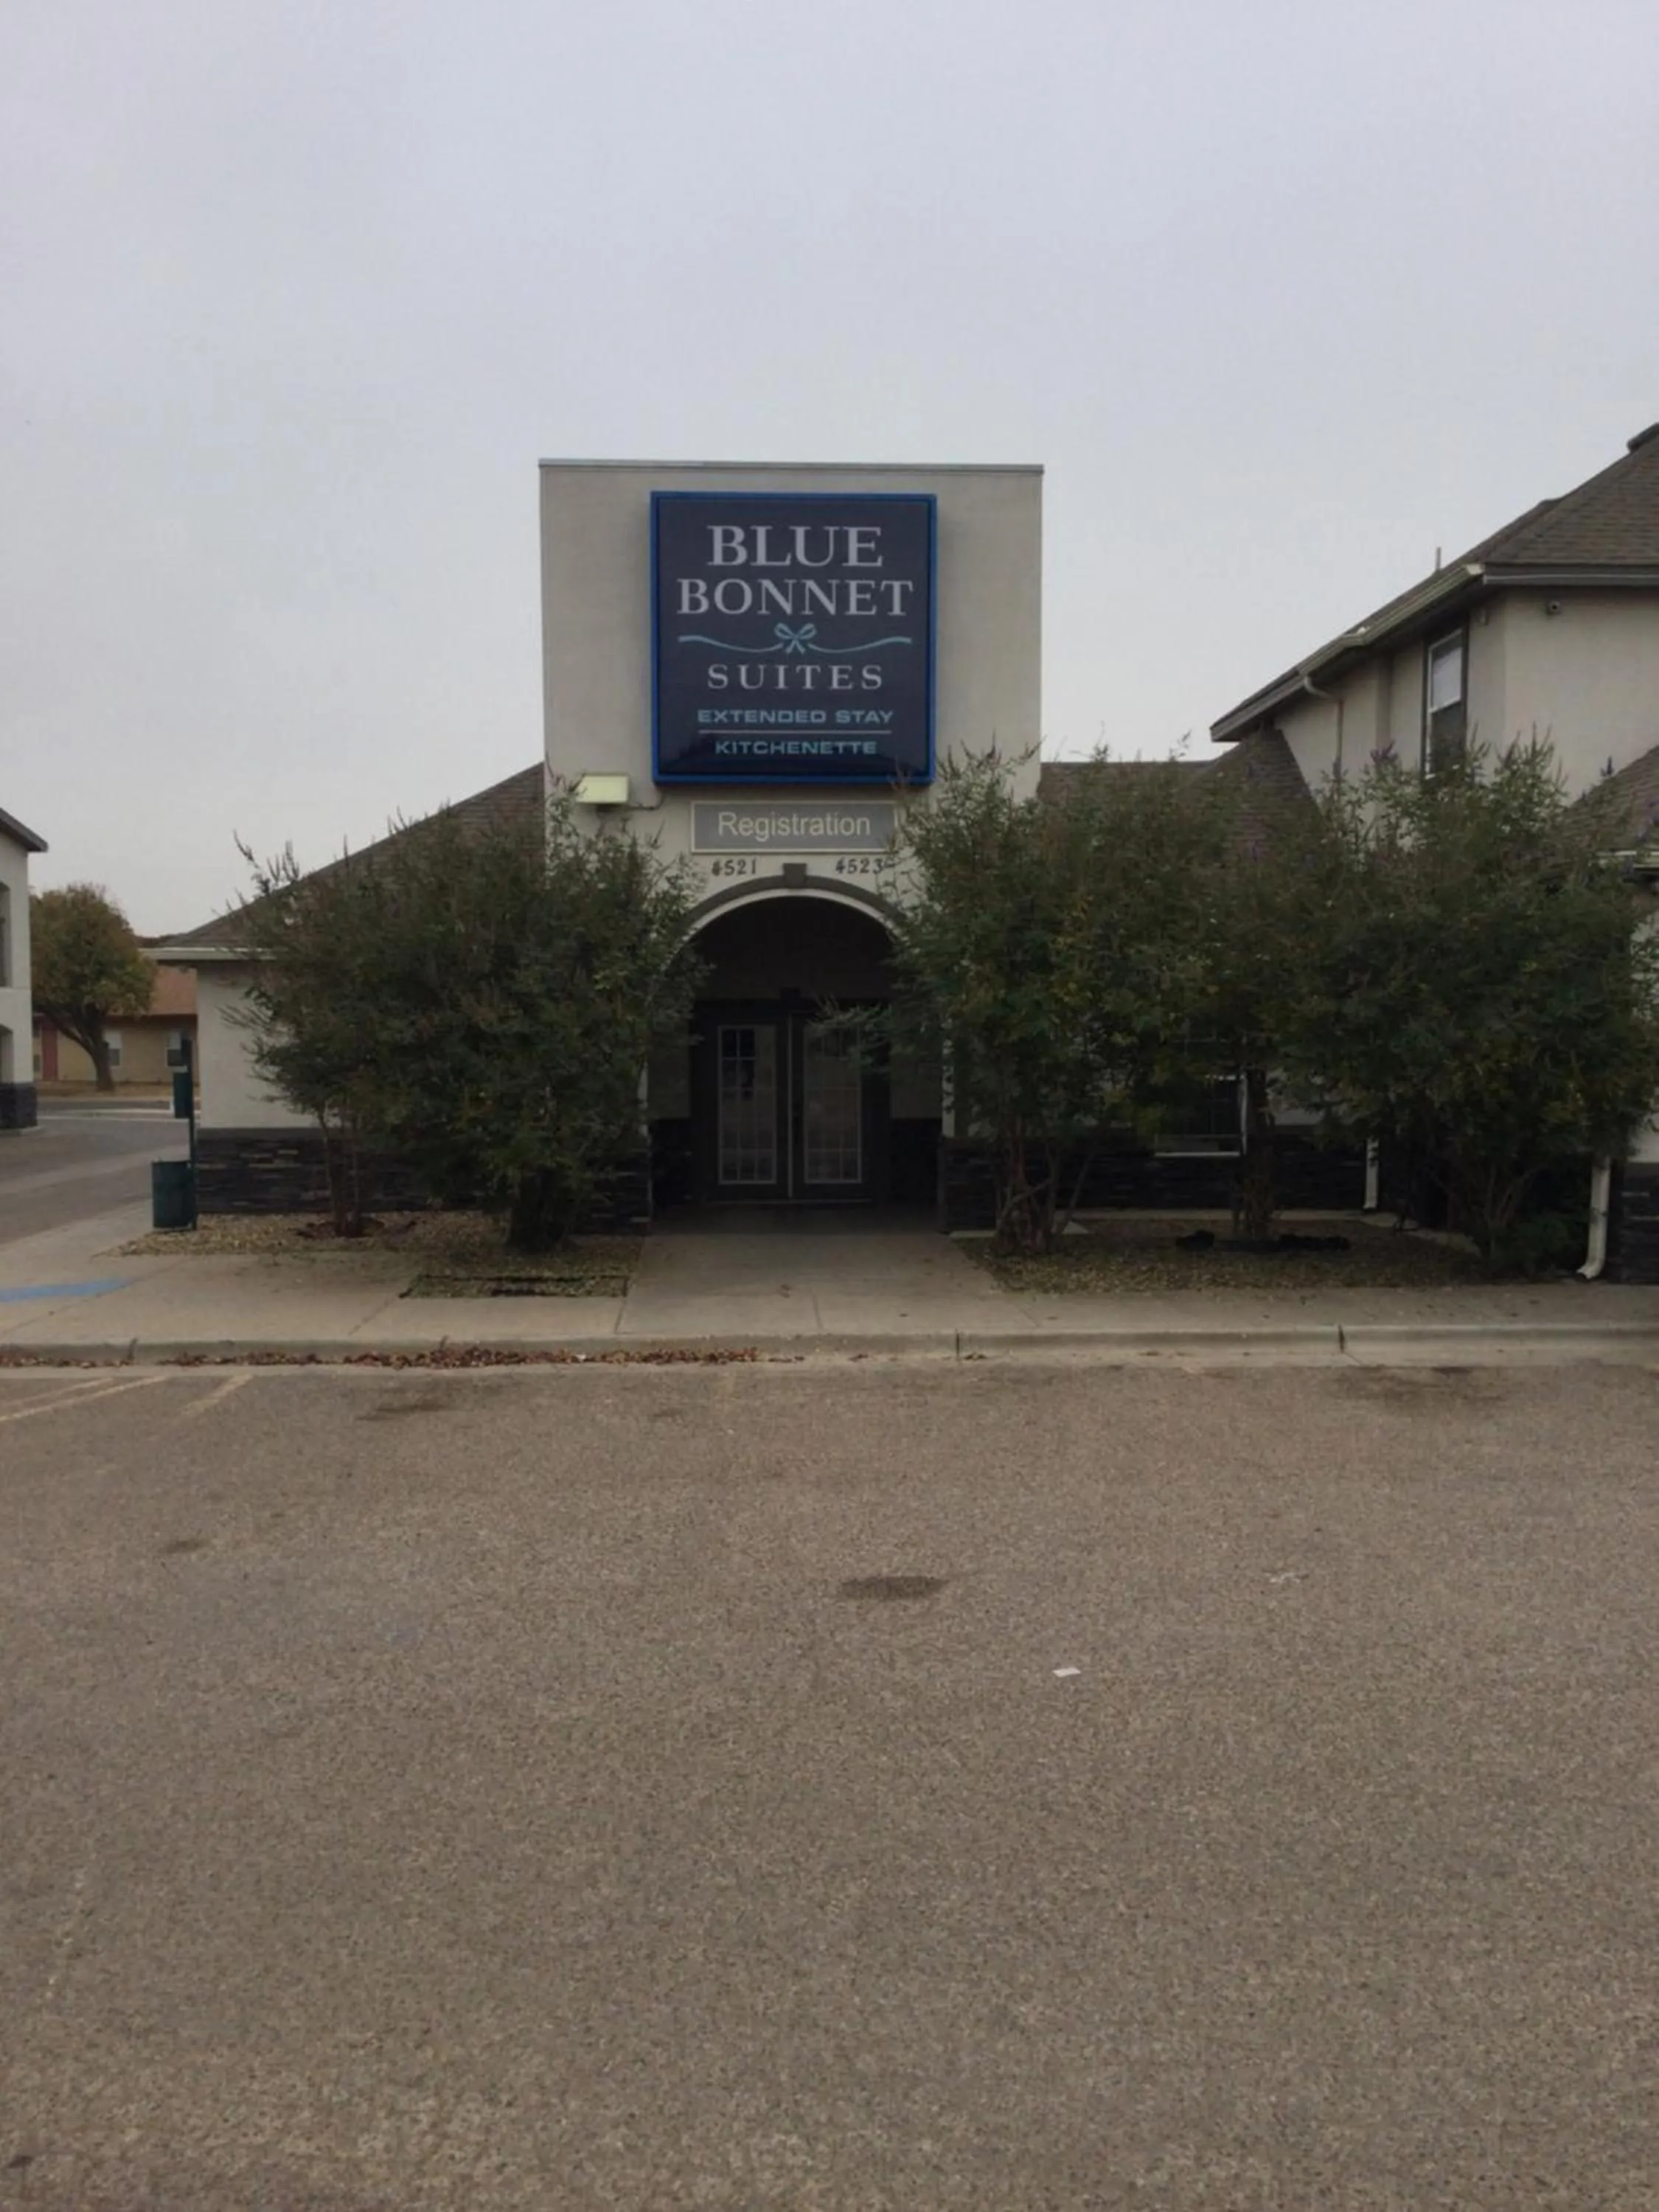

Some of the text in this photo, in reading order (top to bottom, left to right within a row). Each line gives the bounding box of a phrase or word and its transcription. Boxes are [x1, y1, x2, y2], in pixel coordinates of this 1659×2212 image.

[707, 525, 883, 567] BLUE
[676, 578, 914, 616] BONNET
[707, 664, 883, 690] SUITES
[698, 710, 894, 723] EXTENDED STAY
[715, 741, 877, 754] KITCHENETTE
[717, 811, 871, 843] Registration
